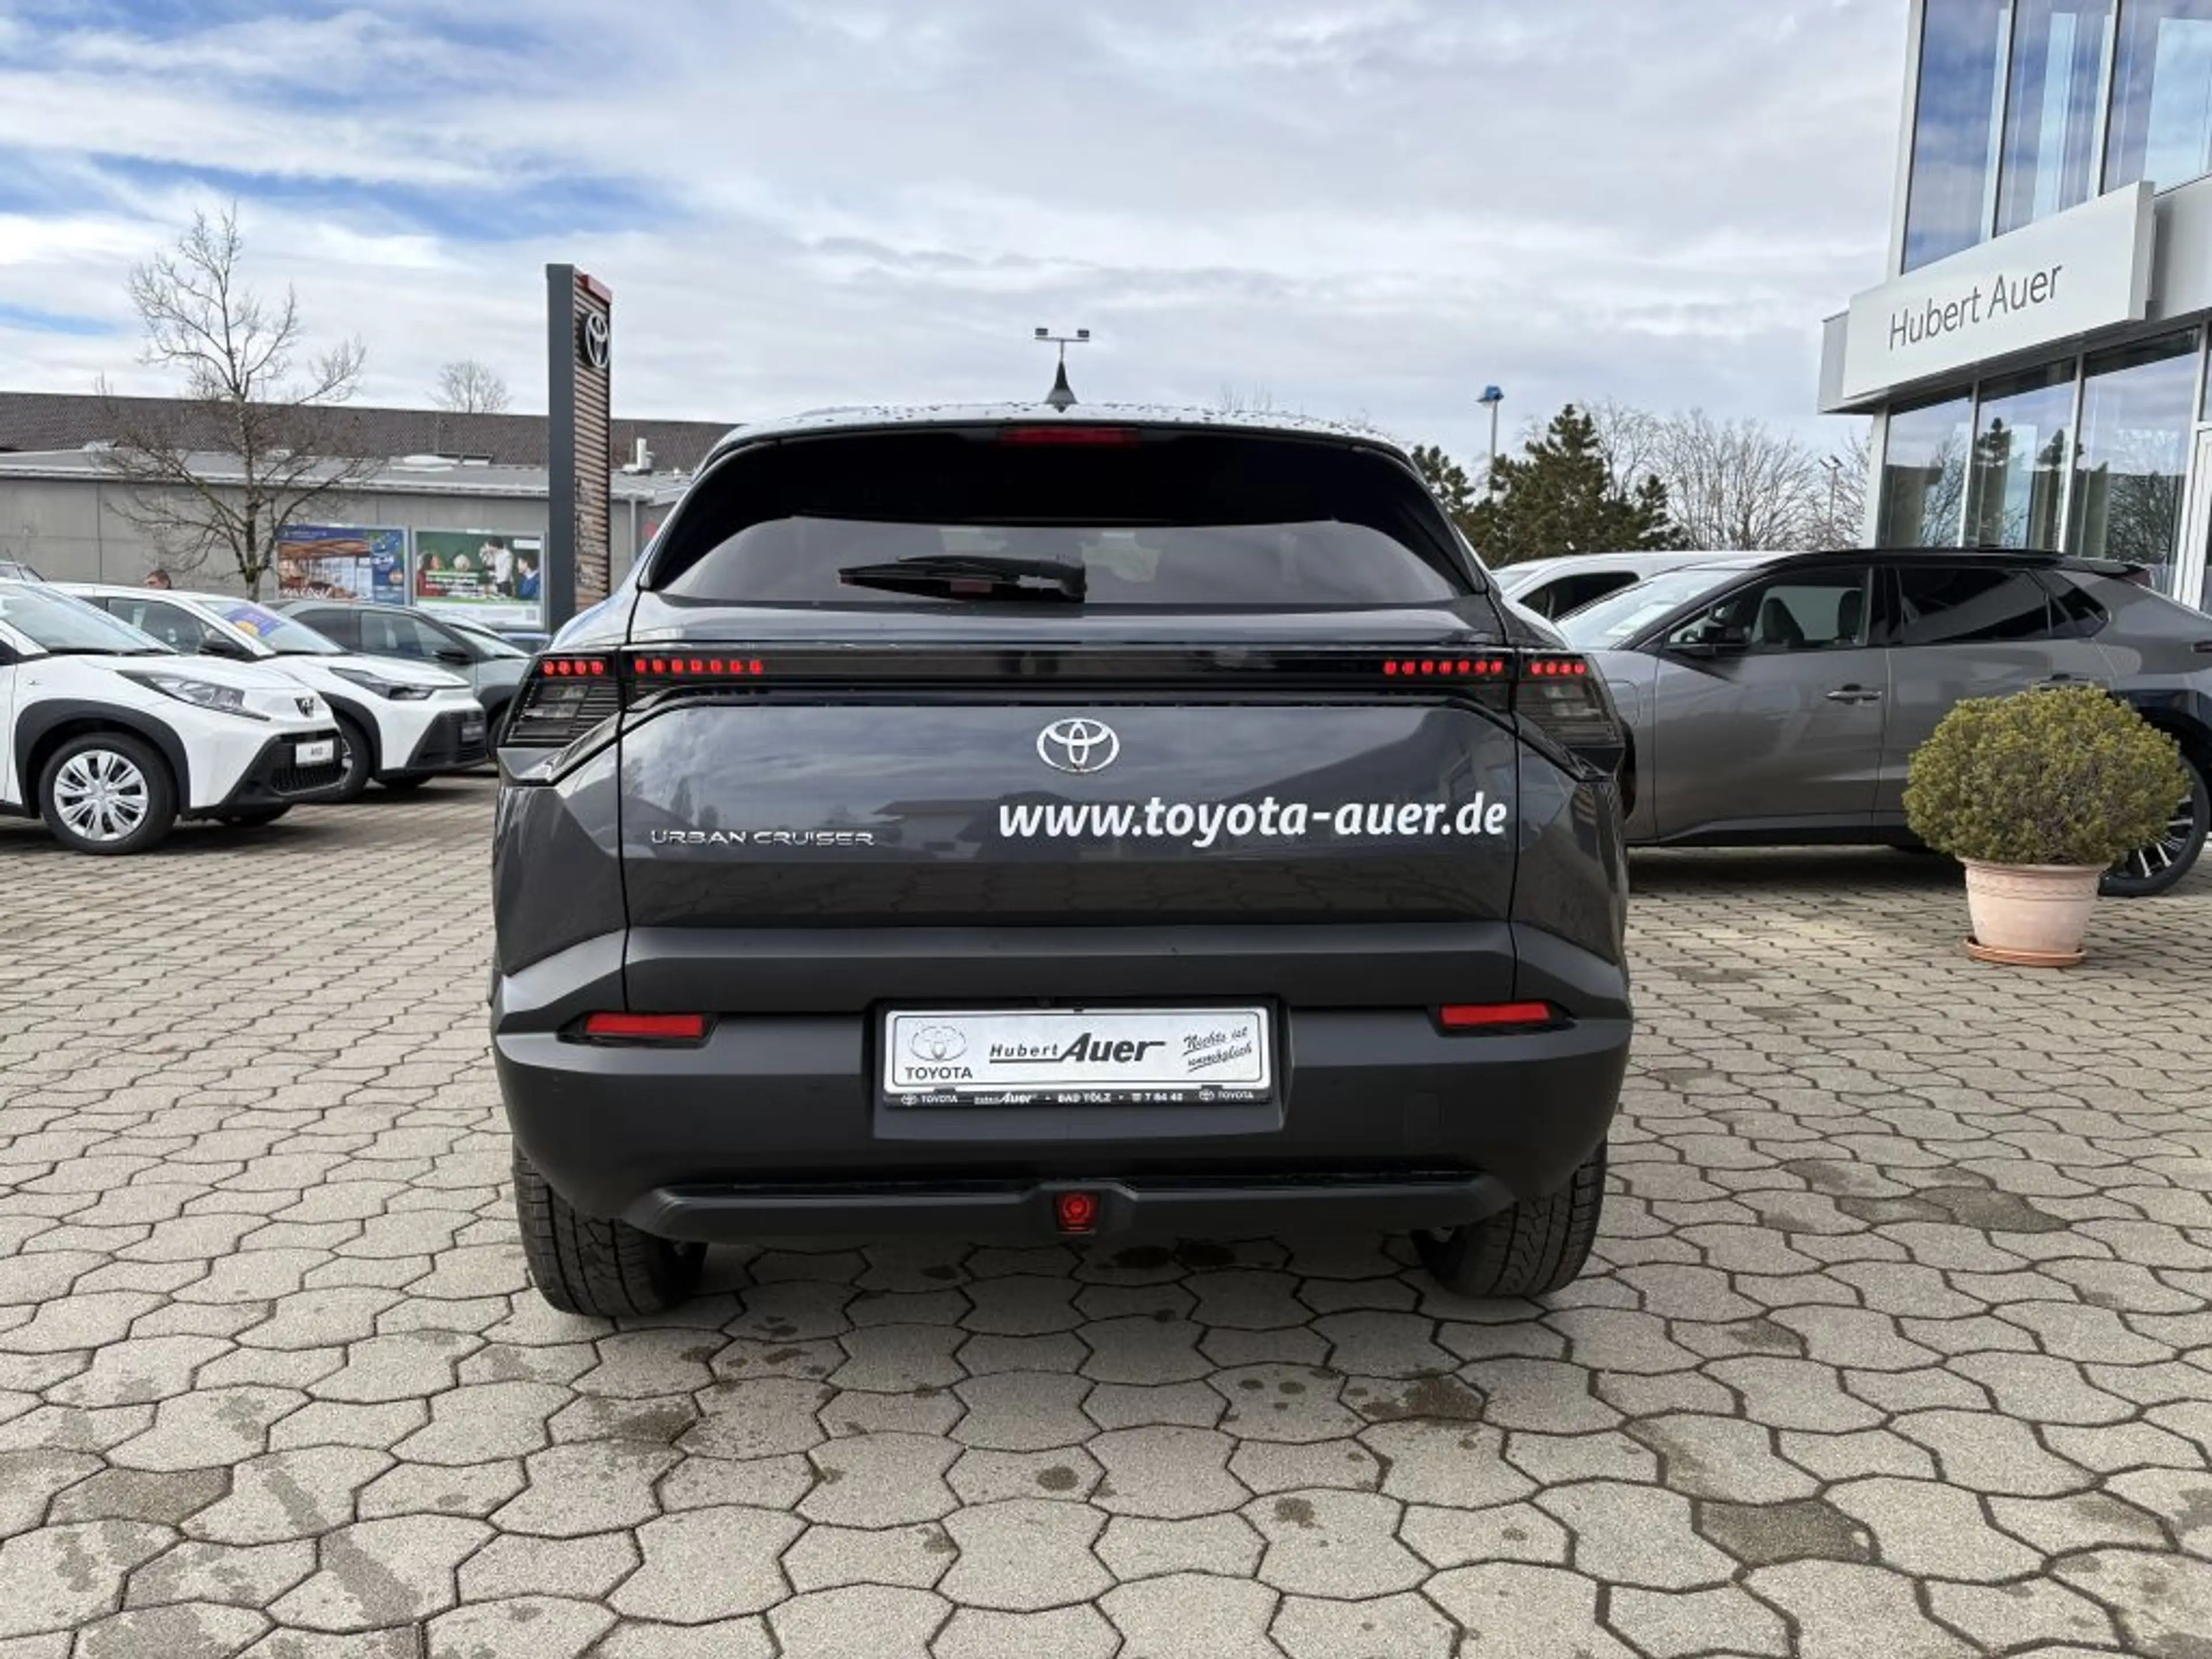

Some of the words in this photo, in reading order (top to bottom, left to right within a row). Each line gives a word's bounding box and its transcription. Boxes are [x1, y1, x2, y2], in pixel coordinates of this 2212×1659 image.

[1889, 286, 1982, 351] Hubert
[1987, 265, 2062, 319] Auer
[998, 790, 1507, 848] www.toyota-auer.de
[650, 830, 747, 844] URBAN
[753, 830, 876, 846] CRUISER
[989, 1043, 1059, 1058] Hubert
[1059, 1032, 1166, 1062] Auer
[905, 1066, 973, 1081] TOYOTA
